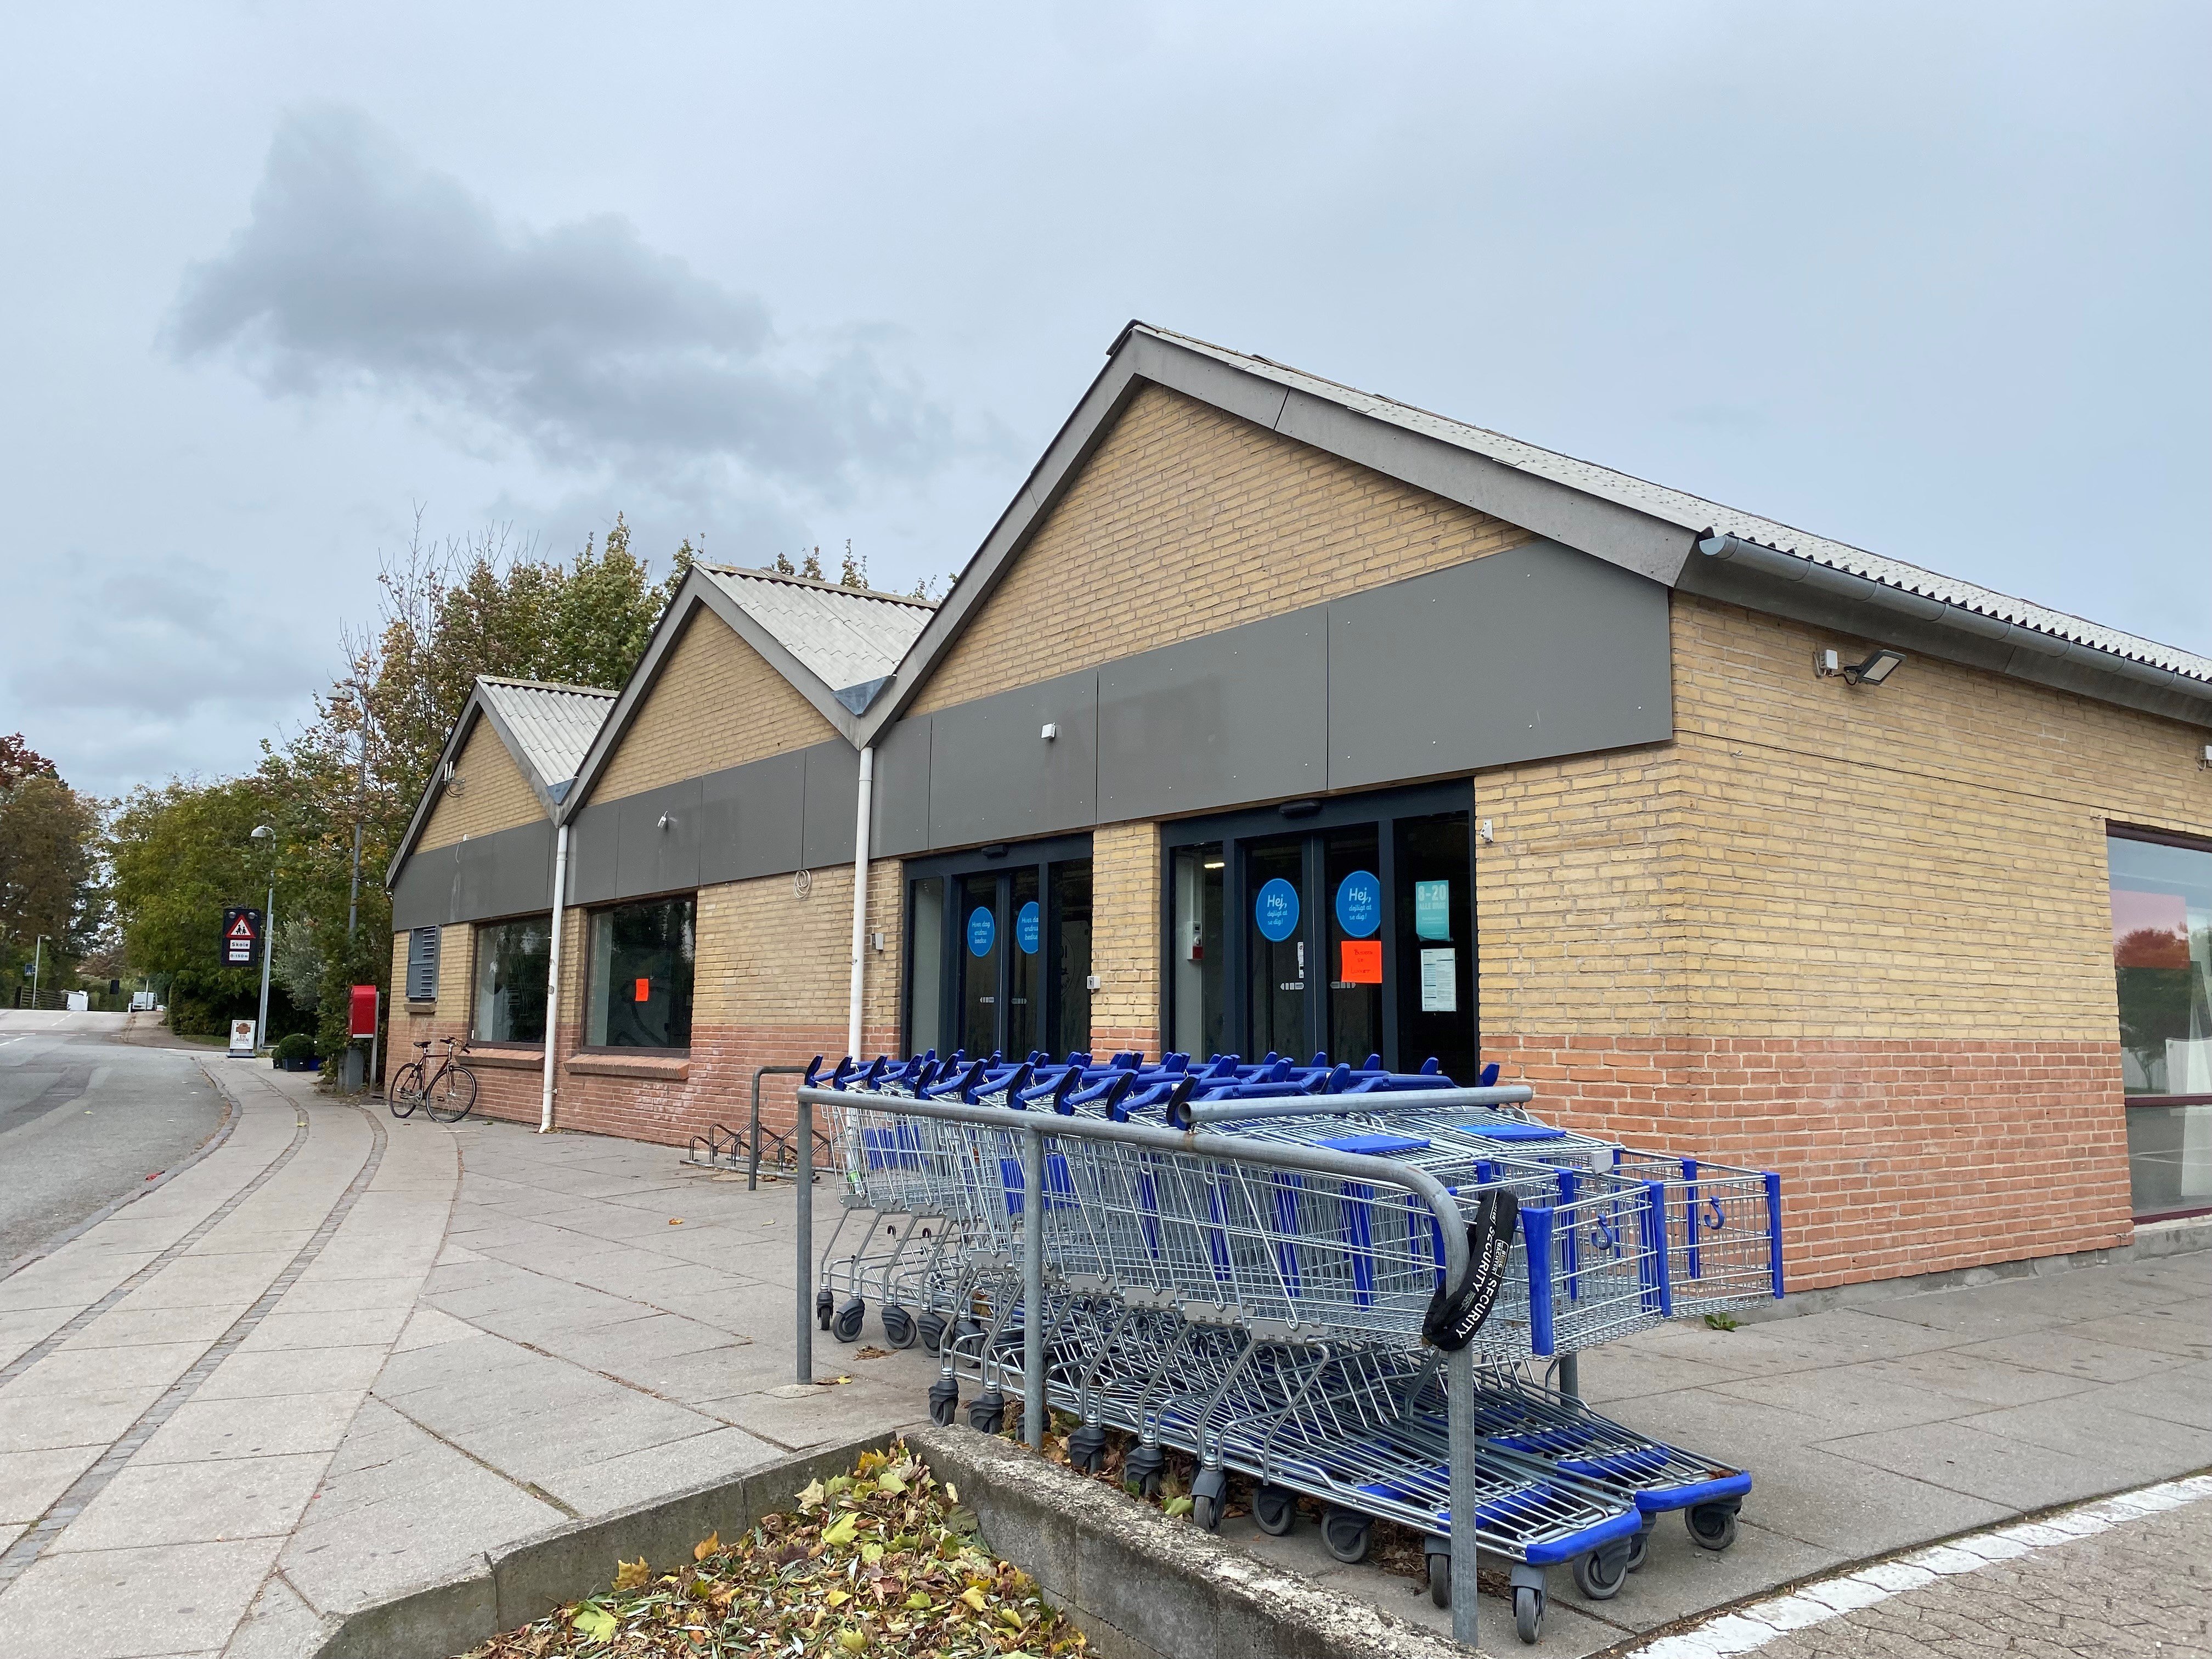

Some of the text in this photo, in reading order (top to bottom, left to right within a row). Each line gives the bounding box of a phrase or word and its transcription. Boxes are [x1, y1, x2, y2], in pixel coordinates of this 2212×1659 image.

[1348, 887, 1372, 904] Hej,
[1418, 884, 1447, 901] 8-20
[1267, 894, 1288, 910] Hej,
[1472, 1226, 1495, 1293] SECURITY
[1455, 1278, 1497, 1339] SECURITY
